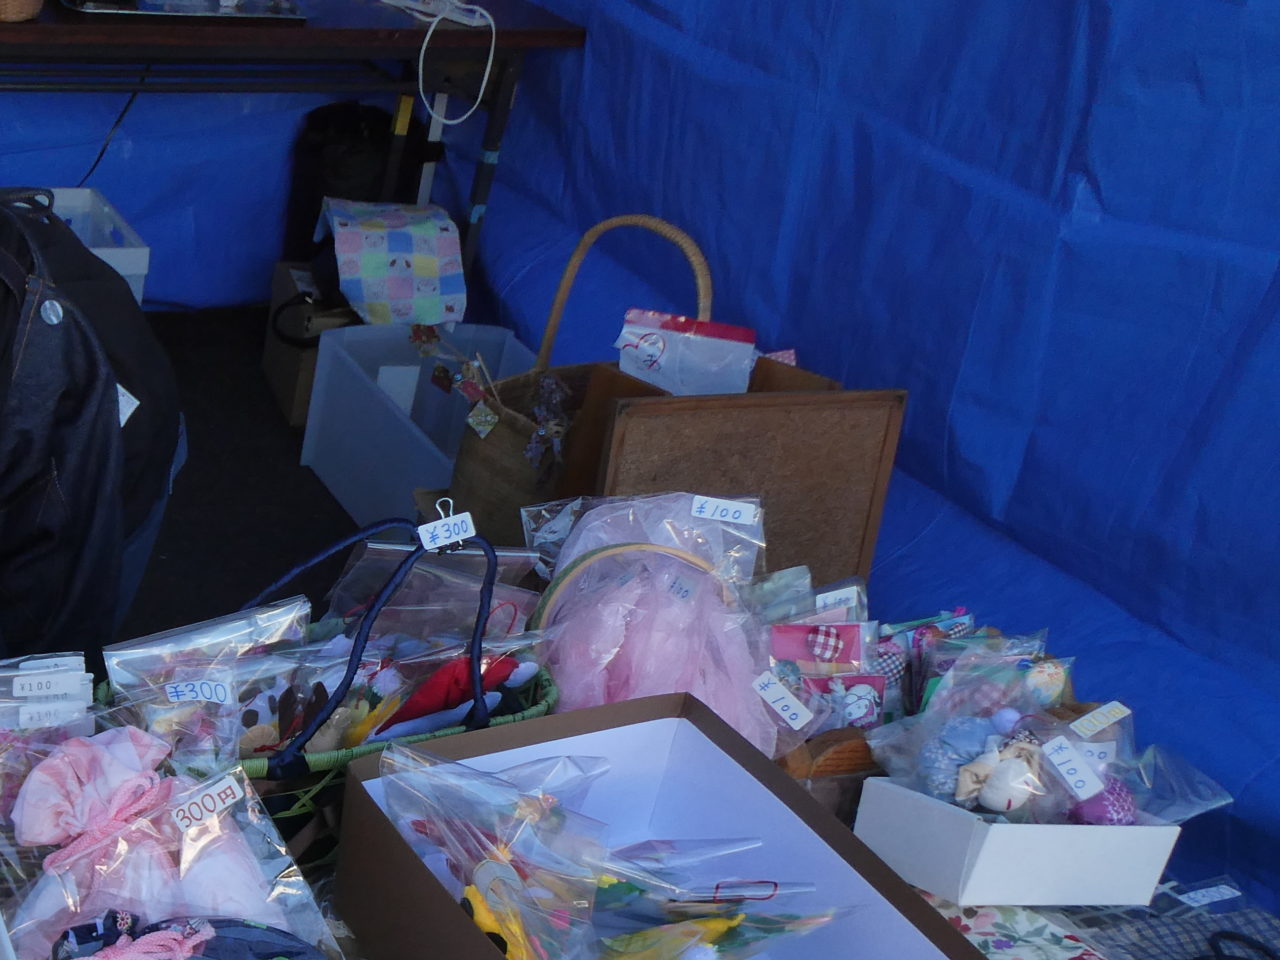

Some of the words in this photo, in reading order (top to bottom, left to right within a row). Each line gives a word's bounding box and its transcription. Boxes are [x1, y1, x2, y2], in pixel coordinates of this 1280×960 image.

[695, 500, 742, 520] ¥100
[425, 519, 468, 545] ¥300
[19, 680, 52, 692] ¥100
[168, 681, 227, 703] ¥300
[758, 679, 799, 721] ¥100
[1048, 742, 1086, 789] ¥100
[175, 784, 238, 828] 300円
